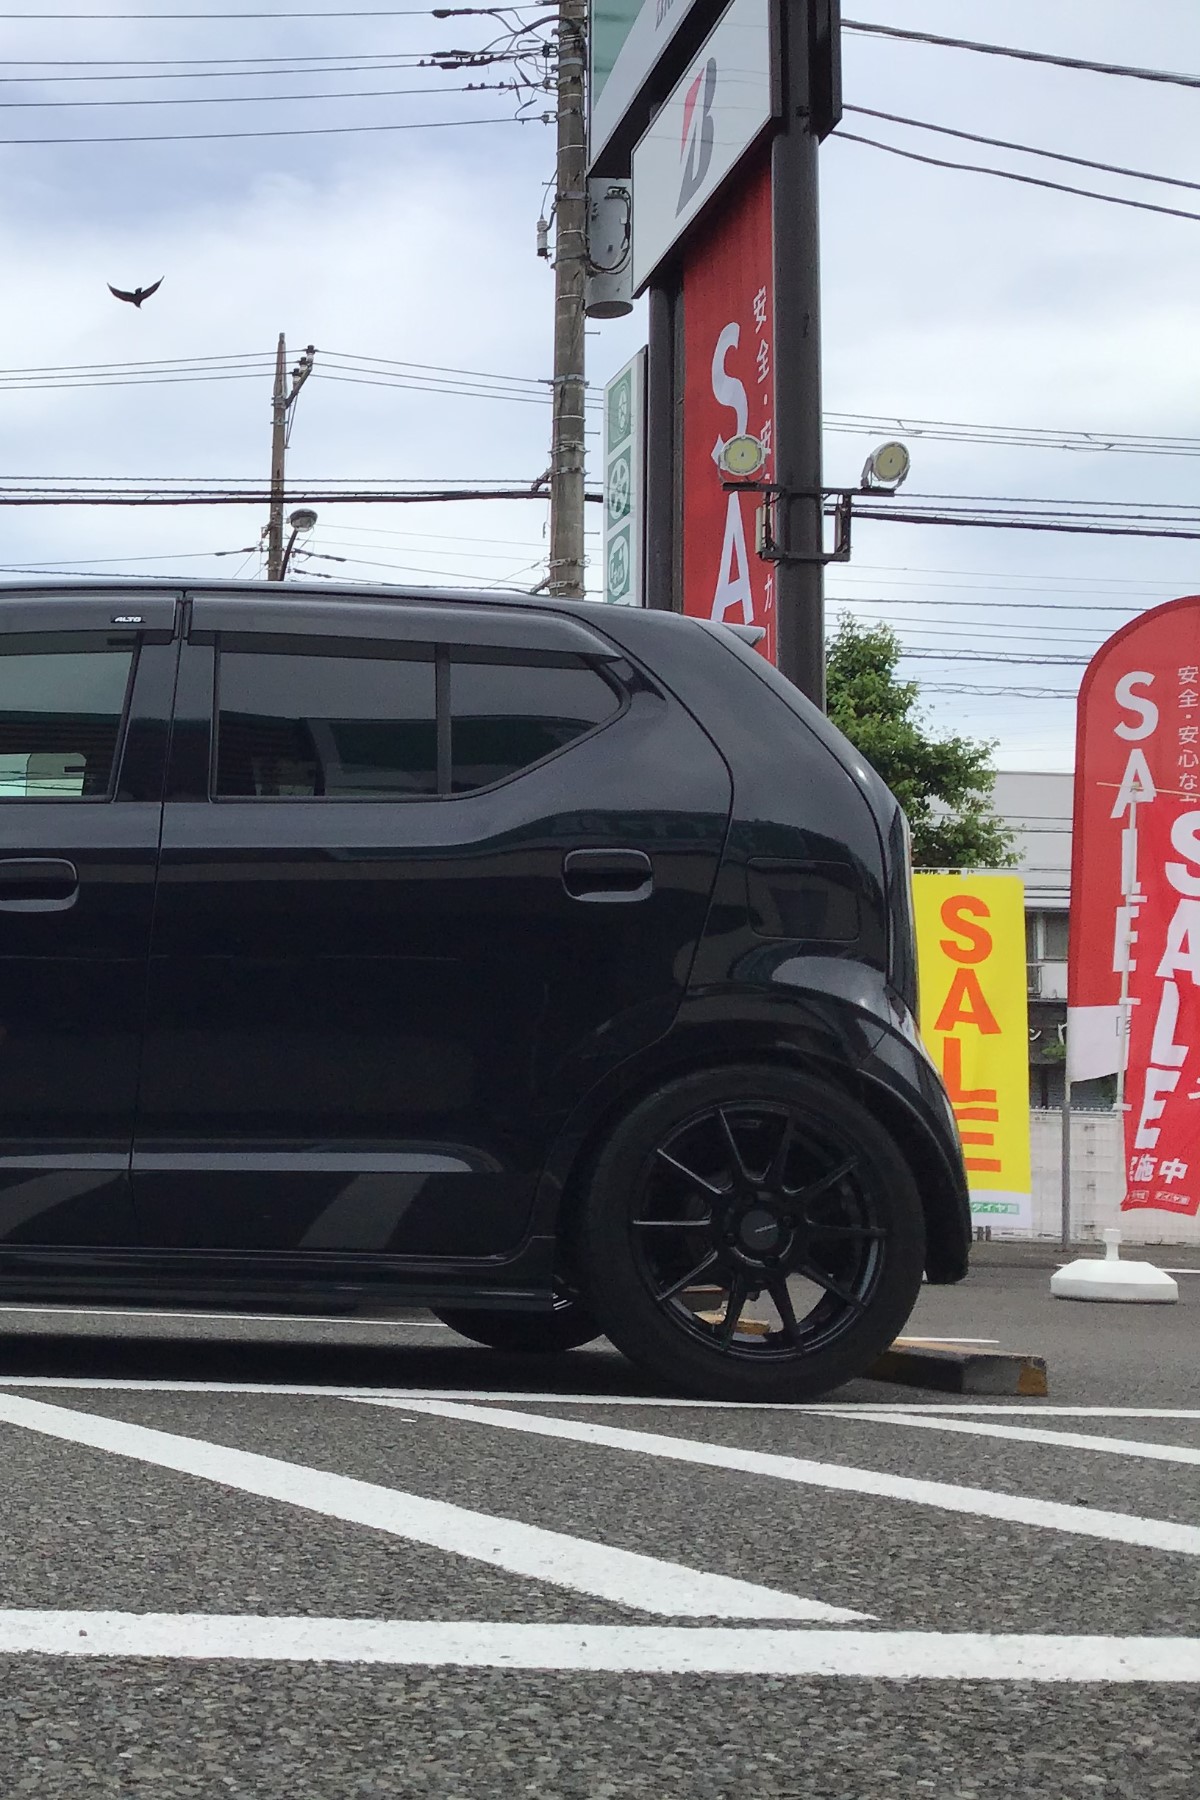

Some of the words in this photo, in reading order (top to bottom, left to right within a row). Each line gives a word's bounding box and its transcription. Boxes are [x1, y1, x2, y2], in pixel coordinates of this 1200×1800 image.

[1177, 666, 1199, 803] 安全・安心な
[933, 895, 1002, 1172] SALE
[1133, 810, 1200, 1150] SALE
